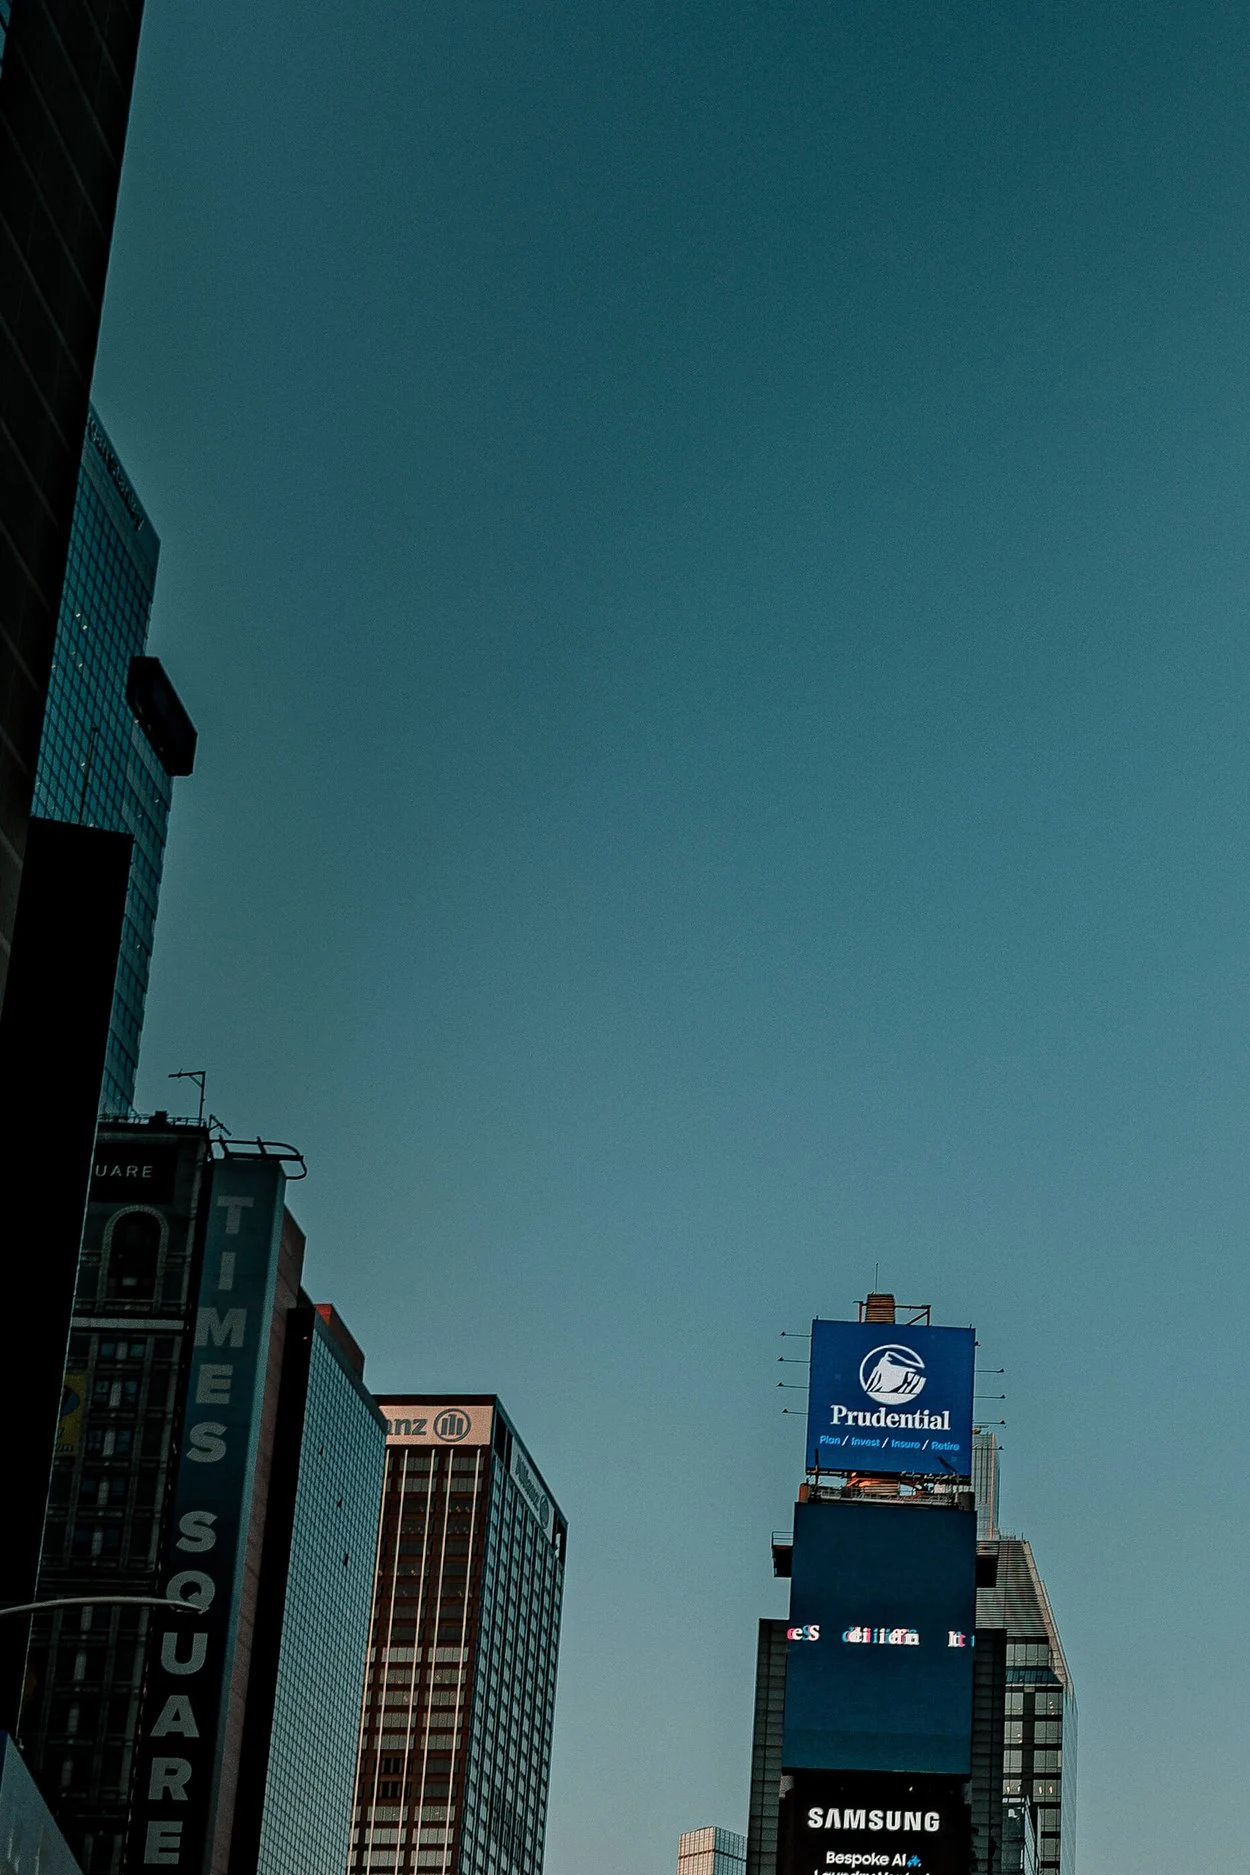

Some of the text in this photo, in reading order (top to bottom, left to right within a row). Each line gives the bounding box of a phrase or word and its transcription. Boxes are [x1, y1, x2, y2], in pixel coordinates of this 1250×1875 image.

[95, 1164, 154, 1179] UARE
[829, 1404, 952, 1431] Prudential
[819, 1434, 961, 1452] Plan Invest Insure Retire
[143, 1195, 255, 1866] TIMES SQUARE
[807, 1806, 941, 1833] SAMSUNG
[825, 1850, 907, 1869] Bespoke AI
